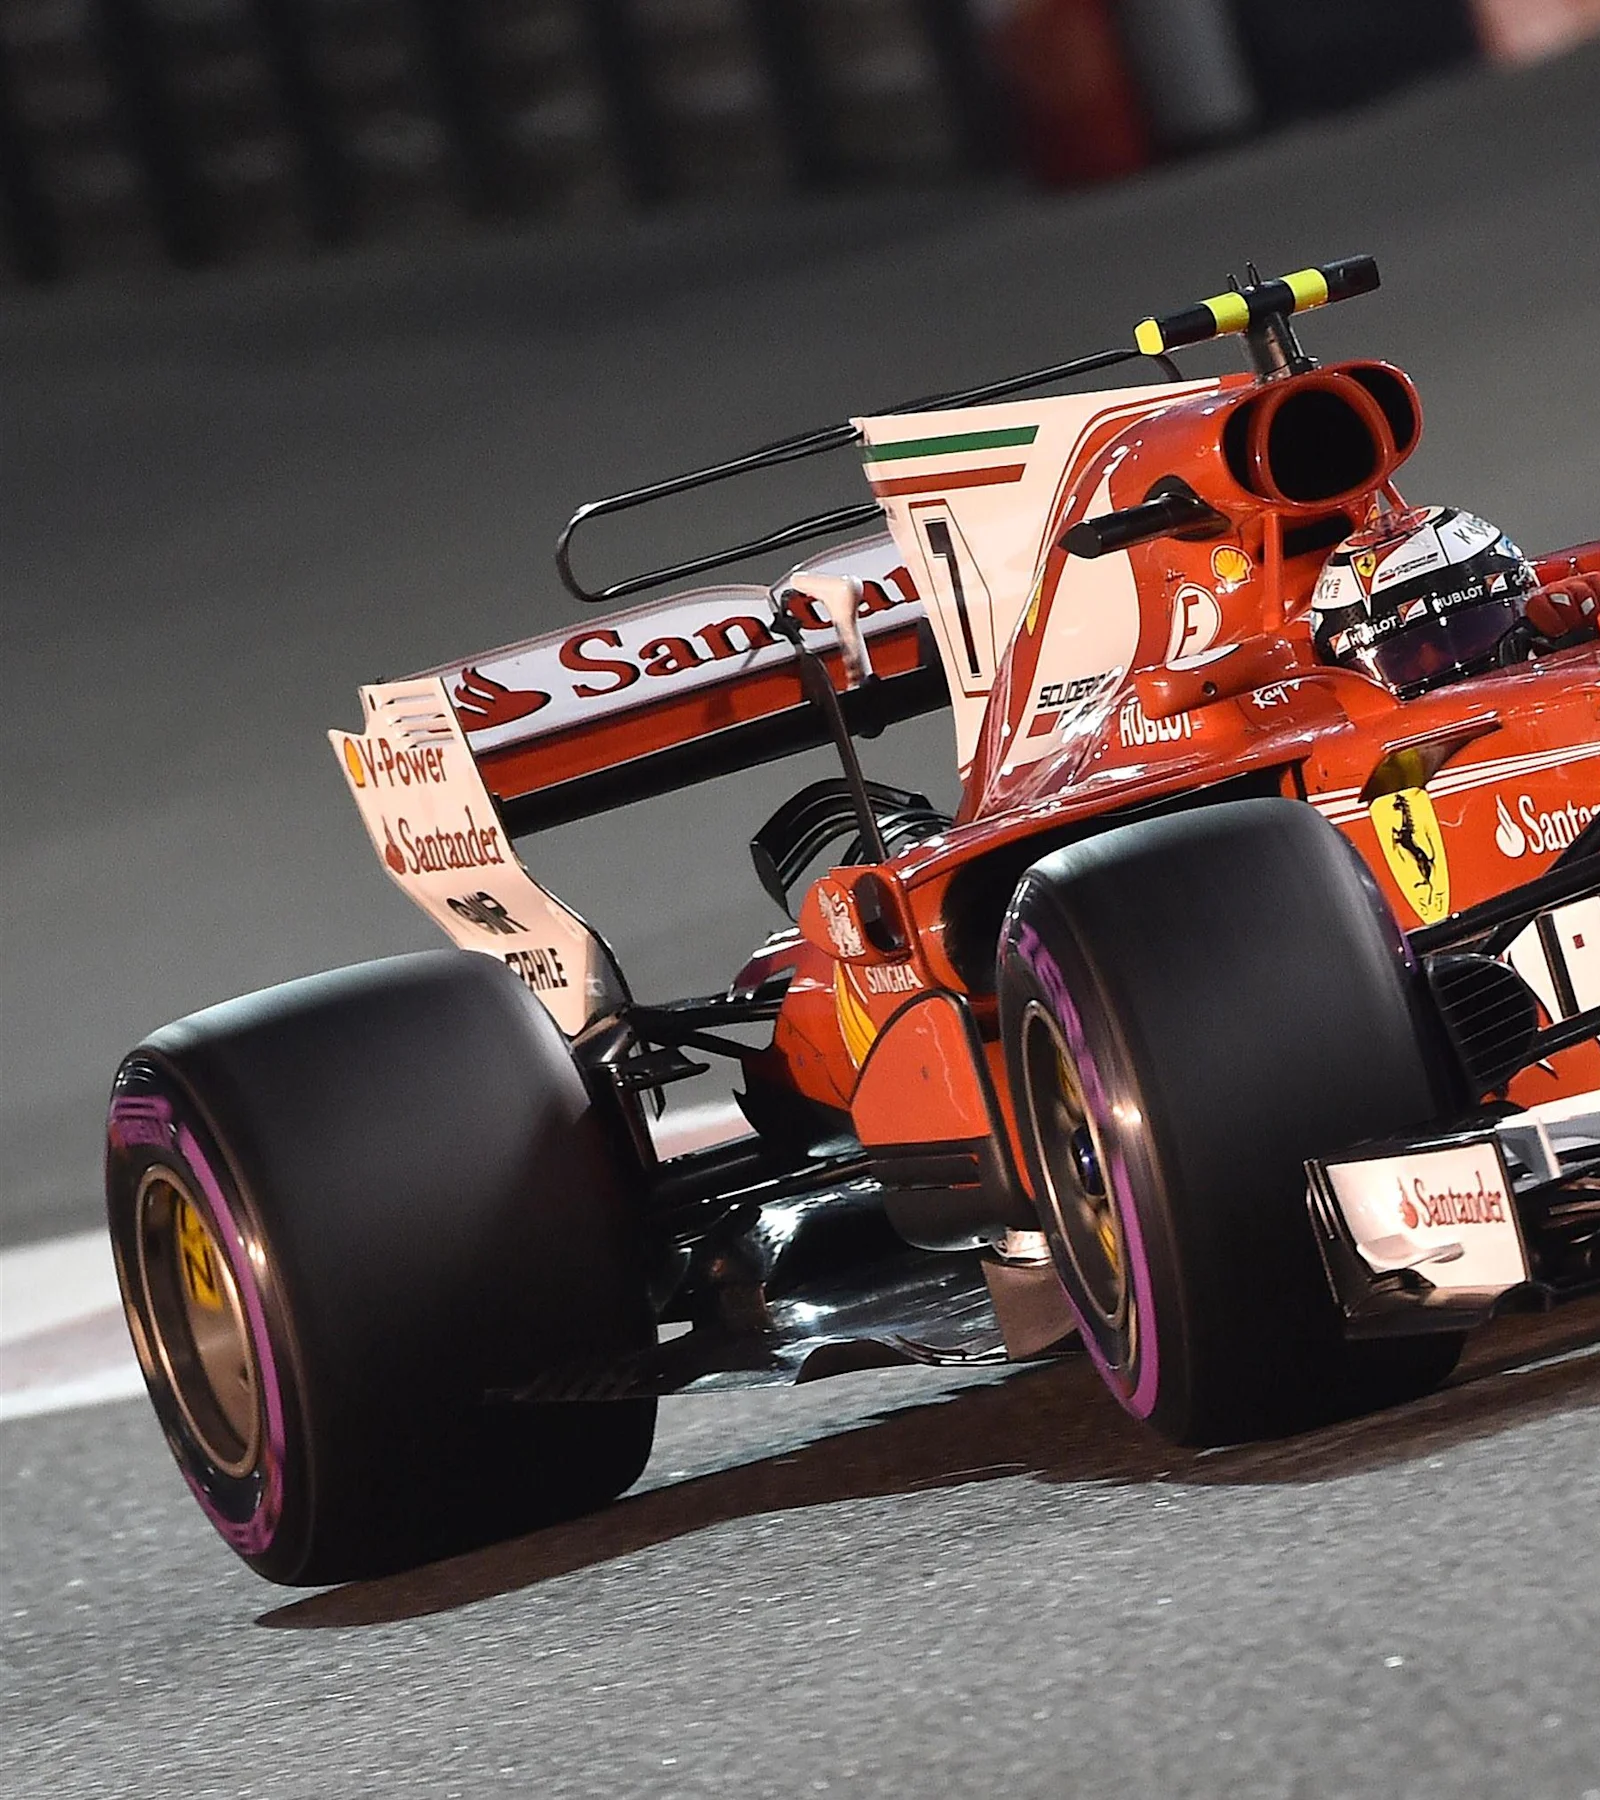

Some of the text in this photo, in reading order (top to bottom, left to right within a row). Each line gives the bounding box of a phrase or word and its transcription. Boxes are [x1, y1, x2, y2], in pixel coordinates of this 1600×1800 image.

[358, 738, 448, 788] V-Power
[398, 806, 506, 875] Santander
[864, 964, 925, 994] SINGHA
[1413, 1170, 1508, 1228] Santander
